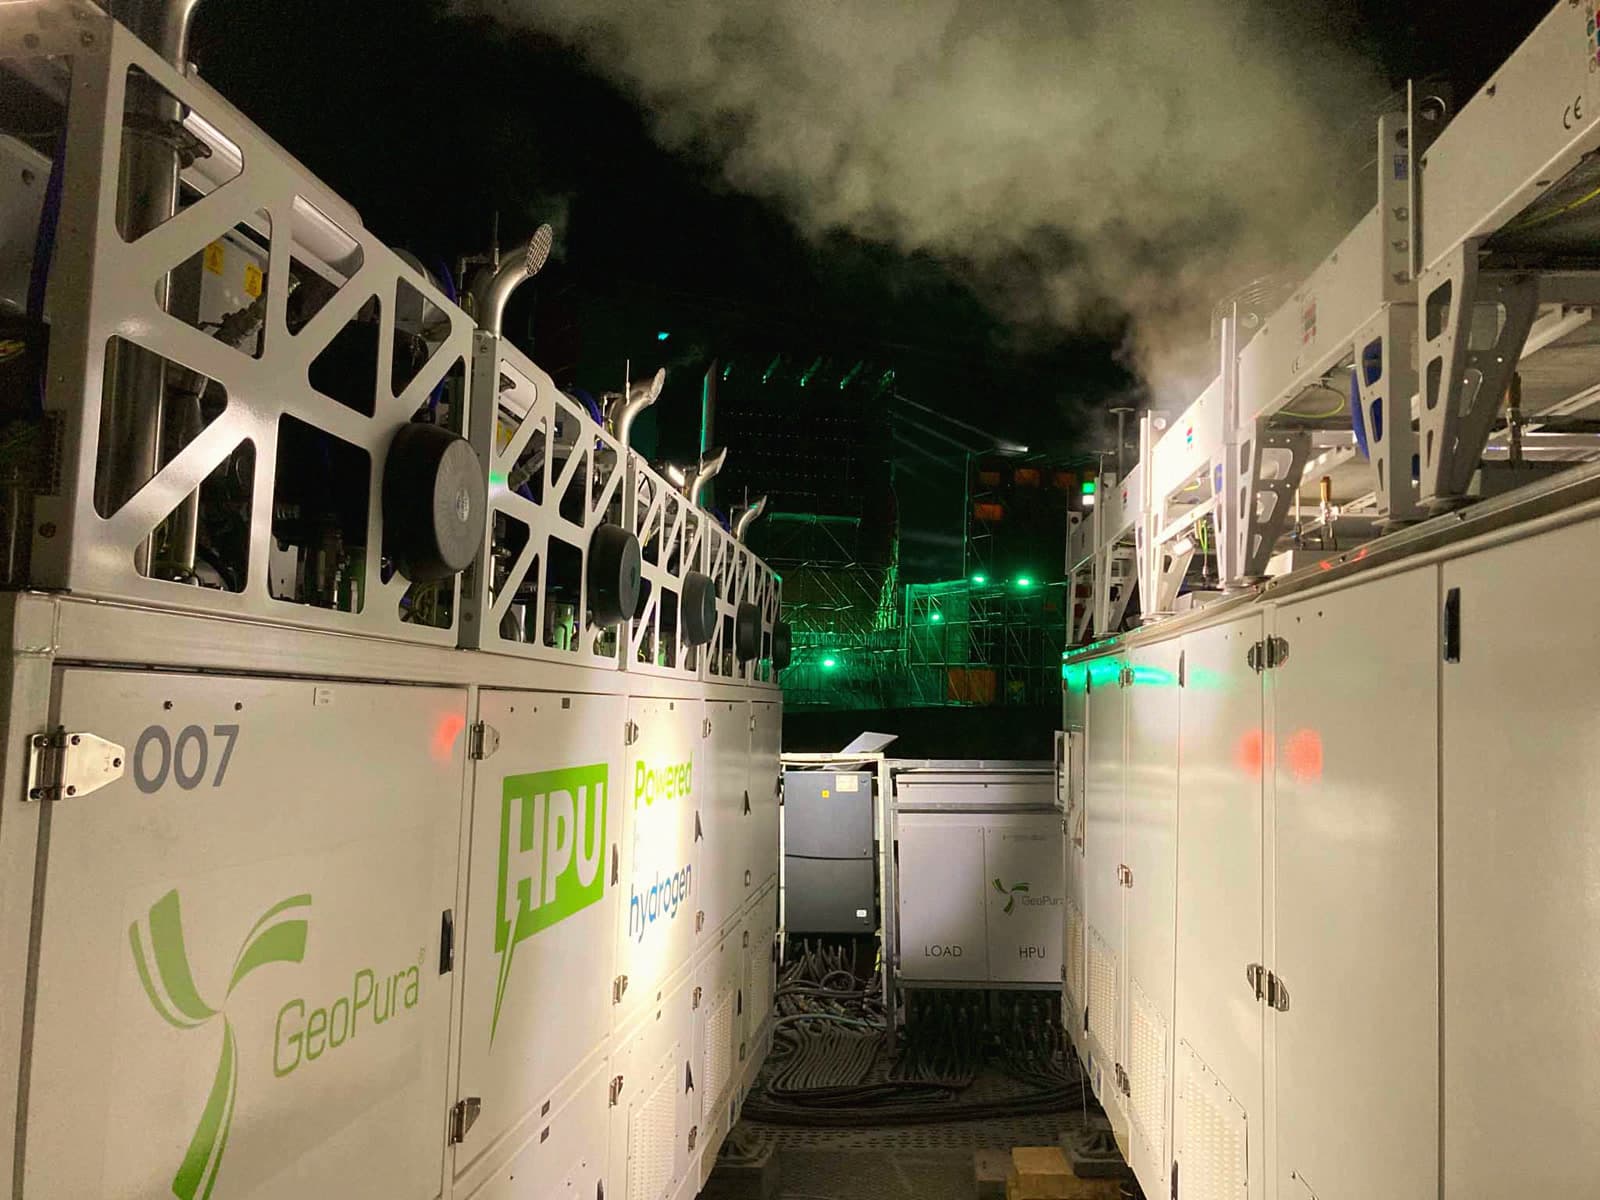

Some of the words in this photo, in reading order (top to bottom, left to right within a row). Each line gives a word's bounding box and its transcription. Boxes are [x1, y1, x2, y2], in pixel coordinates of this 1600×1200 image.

[133, 724, 240, 794] 007
[634, 750, 694, 810] Powered
[504, 783, 604, 922] HPU
[629, 864, 692, 944] hydrogen
[924, 944, 963, 958] LOAD
[1018, 946, 1046, 960] HPU
[273, 965, 420, 1078] GeoPura
